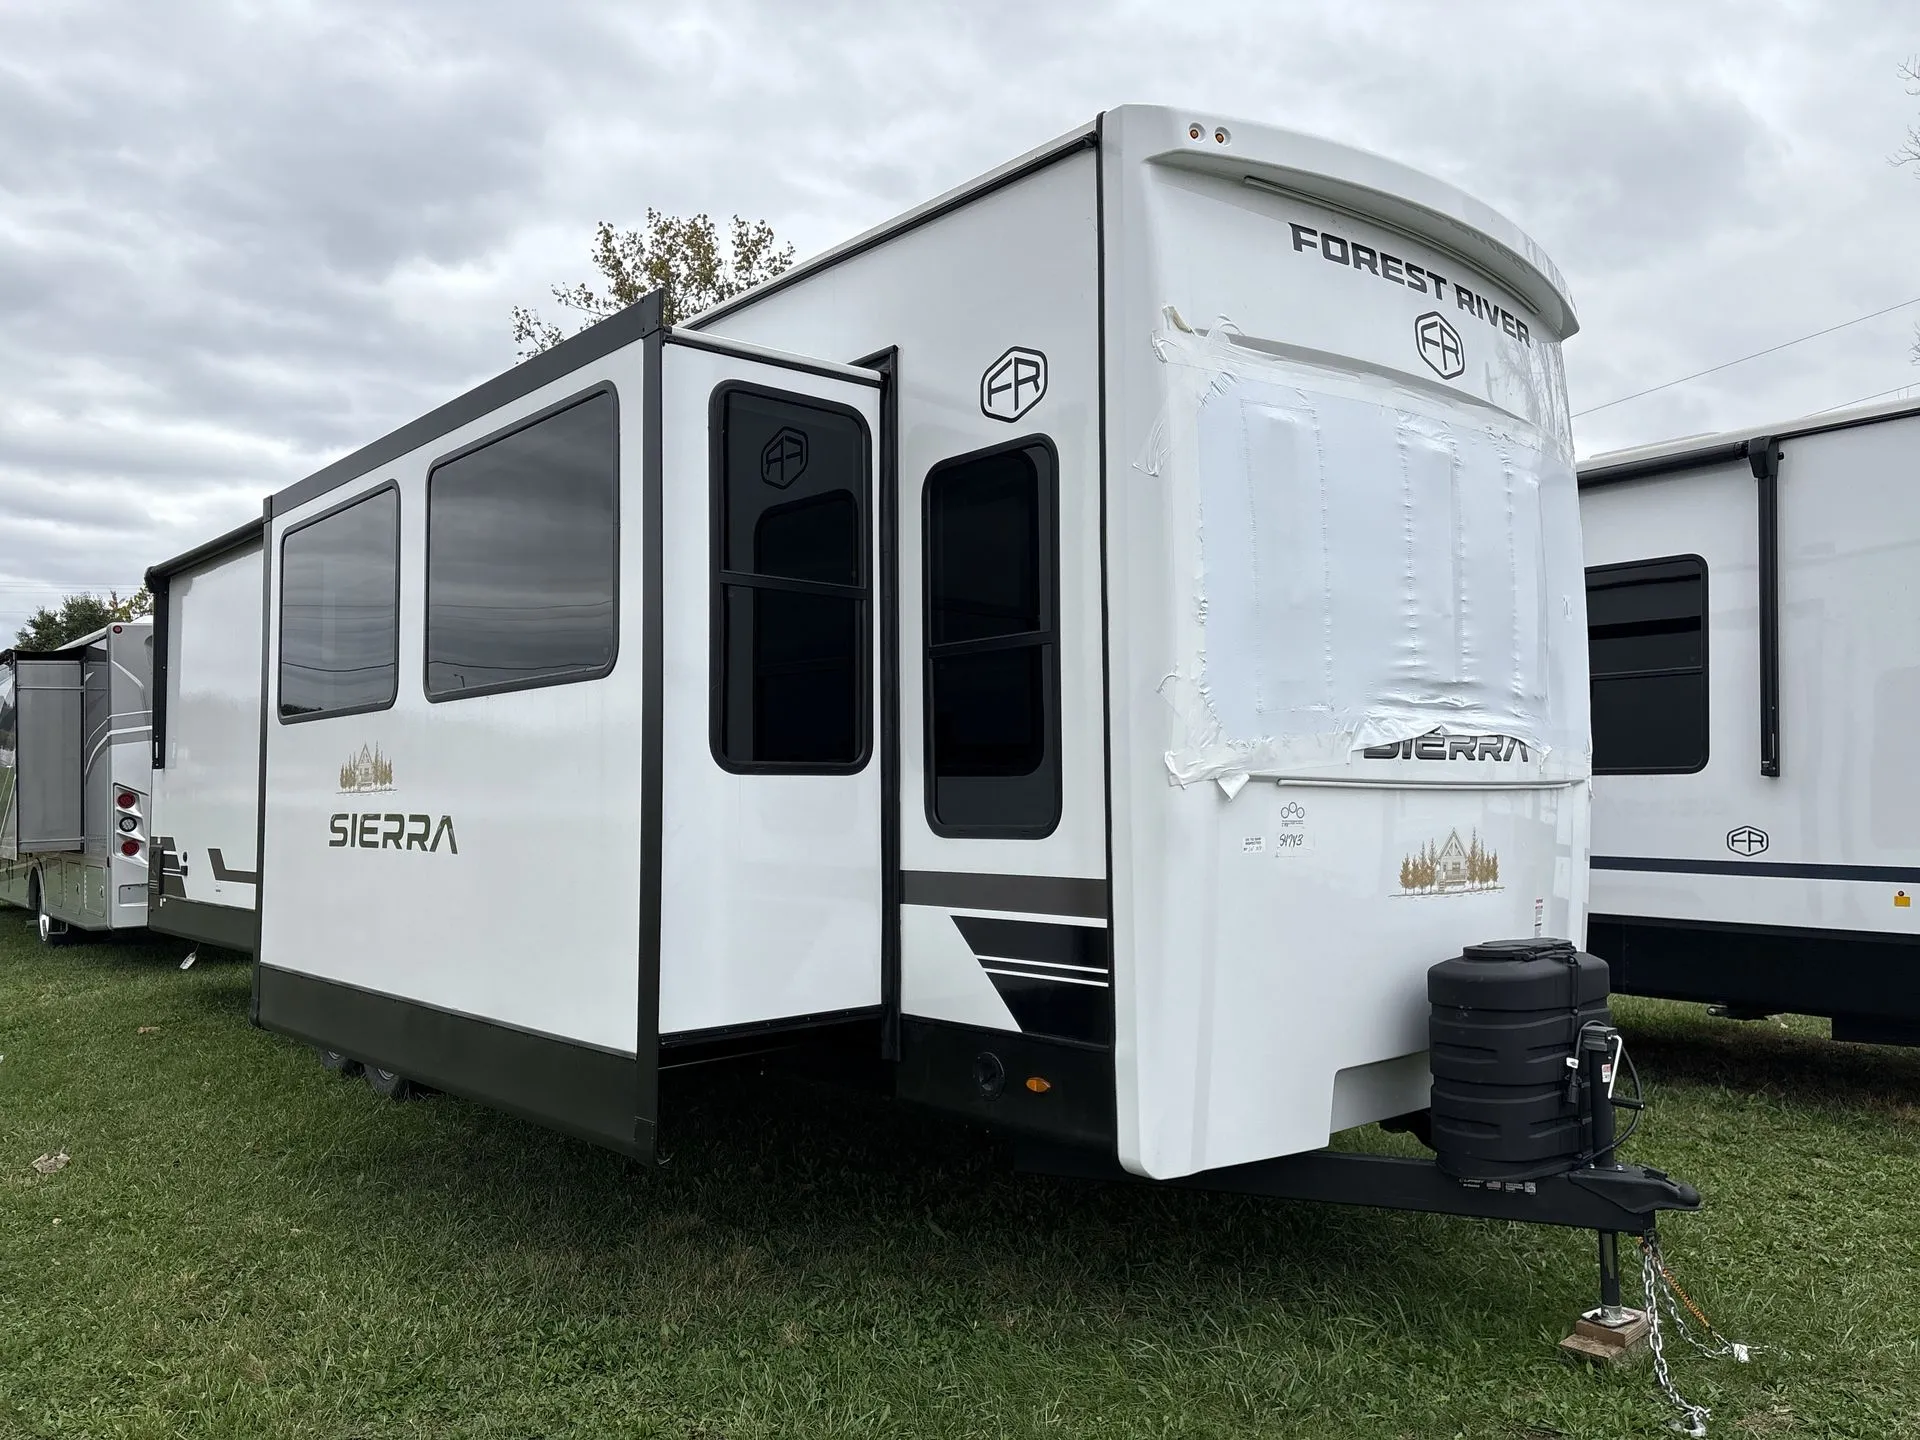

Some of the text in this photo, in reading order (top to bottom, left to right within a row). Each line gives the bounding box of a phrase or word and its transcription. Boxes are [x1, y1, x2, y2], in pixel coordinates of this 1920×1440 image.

[1288, 221, 1533, 349] FOREST RIVER
[1421, 320, 1461, 371] FR
[987, 356, 1041, 412] FR
[329, 812, 459, 856] SIERRA
